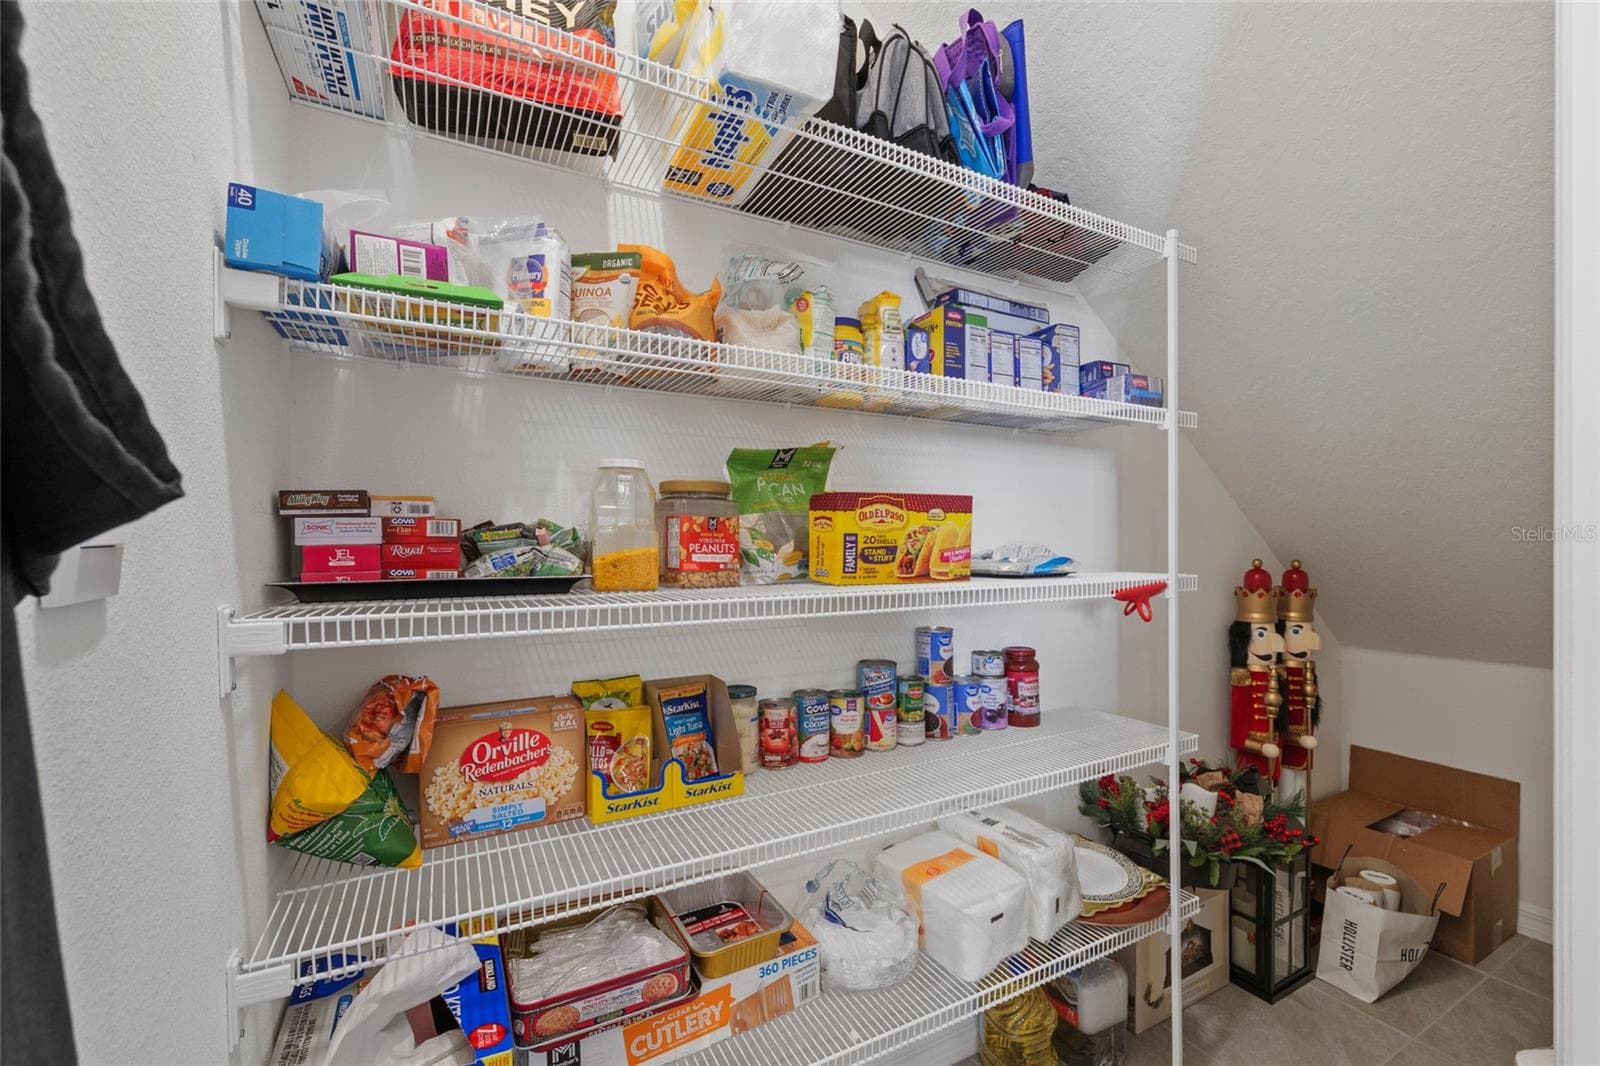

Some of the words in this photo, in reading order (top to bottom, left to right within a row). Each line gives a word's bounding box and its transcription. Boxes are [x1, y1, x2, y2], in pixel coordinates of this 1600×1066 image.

[238, 188, 252, 207] 40
[602, 258, 633, 269] ORGANIC
[573, 286, 612, 298] UINOA
[757, 477, 806, 497] PCAN
[859, 511, 874, 522] OLD
[875, 509, 884, 519] EL
[305, 523, 330, 531] SONIC
[863, 535, 876, 545] 20
[391, 544, 425, 558] Royal
[689, 543, 736, 553] PEANUTS
[863, 548, 887, 556] STAND
[329, 549, 355, 562] JEL
[844, 542, 857, 573] FAMILY
[390, 569, 414, 577] GOYA
[667, 699, 700, 713] StarKist
[553, 720, 577, 729] REAL
[686, 721, 704, 731] Tuna
[471, 733, 541, 765] Orville
[460, 744, 553, 784] Redenbacher's
[478, 780, 534, 798] NATURALS
[686, 780, 733, 799] StarKist
[491, 802, 524, 814] SIMPLY
[606, 796, 659, 815] StarKist
[491, 809, 525, 820] SALTED
[502, 818, 513, 828] 12
[1339, 918, 1359, 972] HOLLISTER
[759, 966, 779, 979] 360
[782, 947, 817, 969] PIECES
[483, 959, 497, 990] KIRKLAND
[667, 1006, 692, 1021] CLEAR
[631, 1001, 724, 1057] CUTLERY
